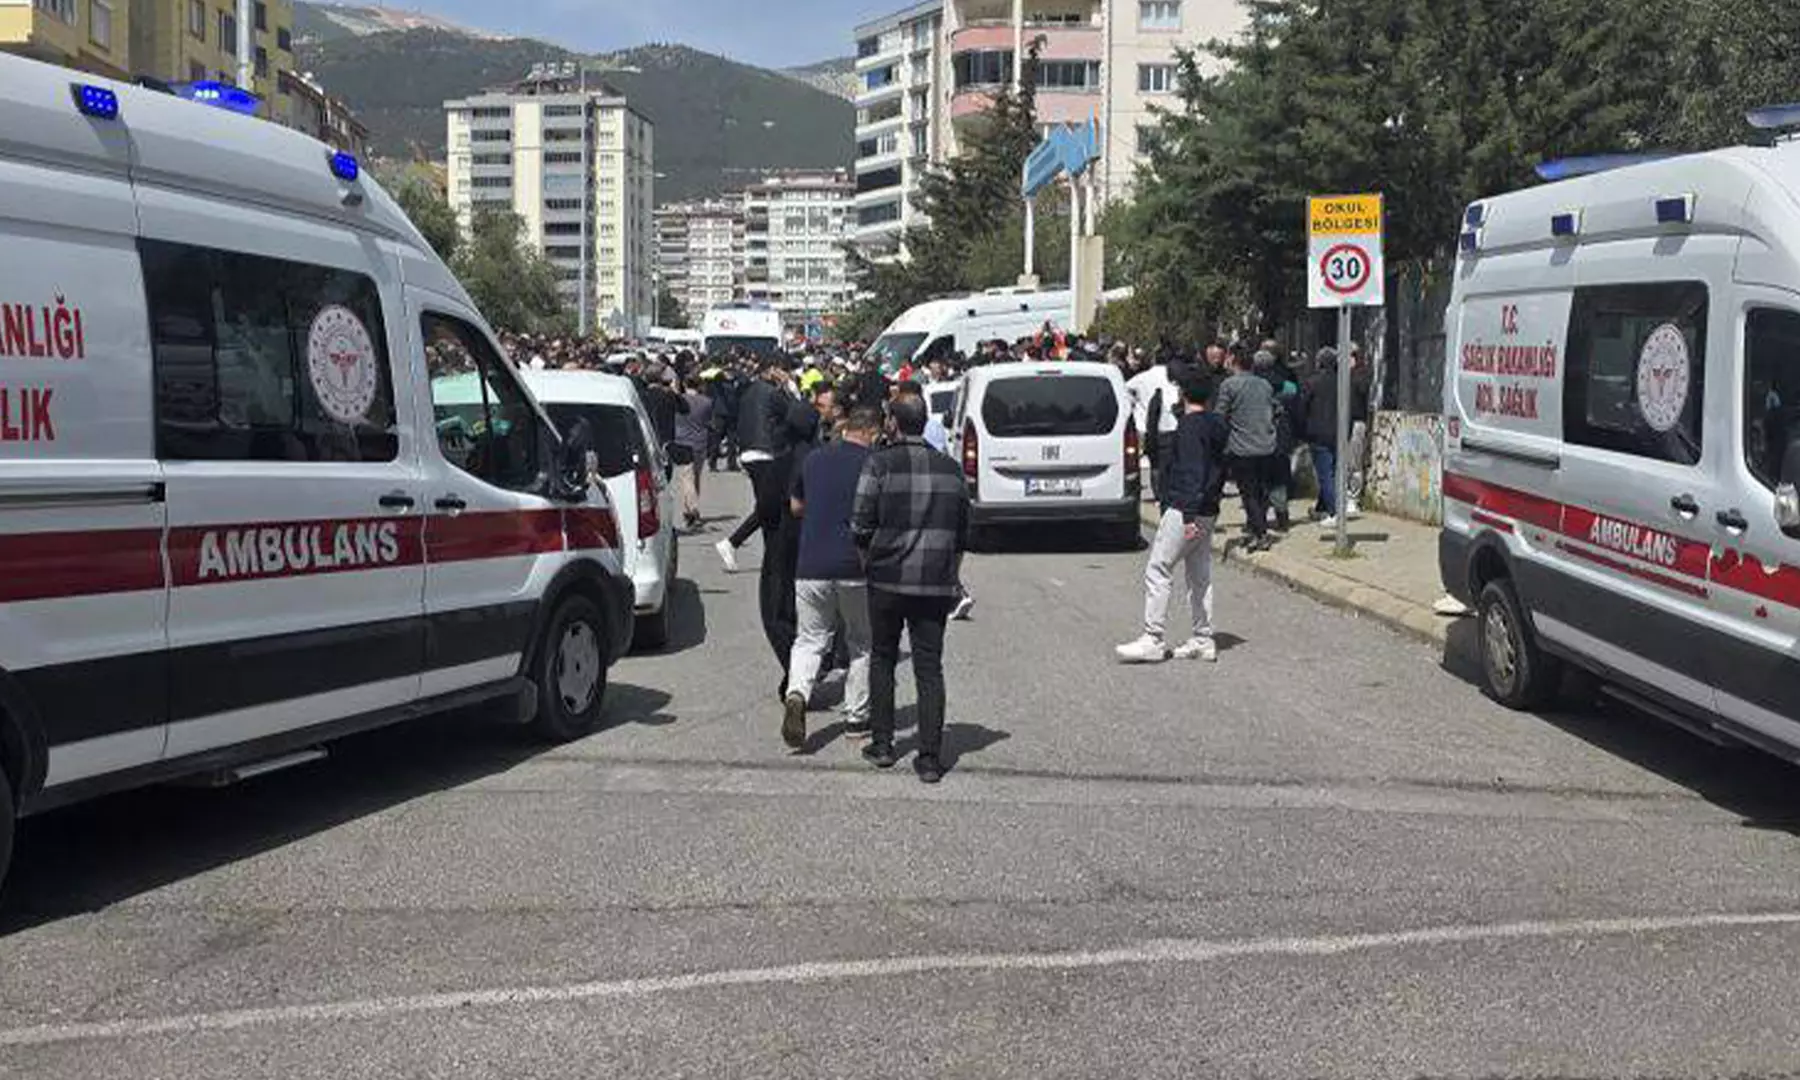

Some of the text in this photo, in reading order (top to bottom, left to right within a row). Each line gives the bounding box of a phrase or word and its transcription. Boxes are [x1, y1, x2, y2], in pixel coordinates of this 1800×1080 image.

[1324, 202, 1365, 214] OKUL
[1312, 217, 1378, 231] BÖLGESİ
[1331, 257, 1360, 280] 30
[199, 521, 399, 578] AMBULANS
[1590, 516, 1678, 566] AMBULANS
